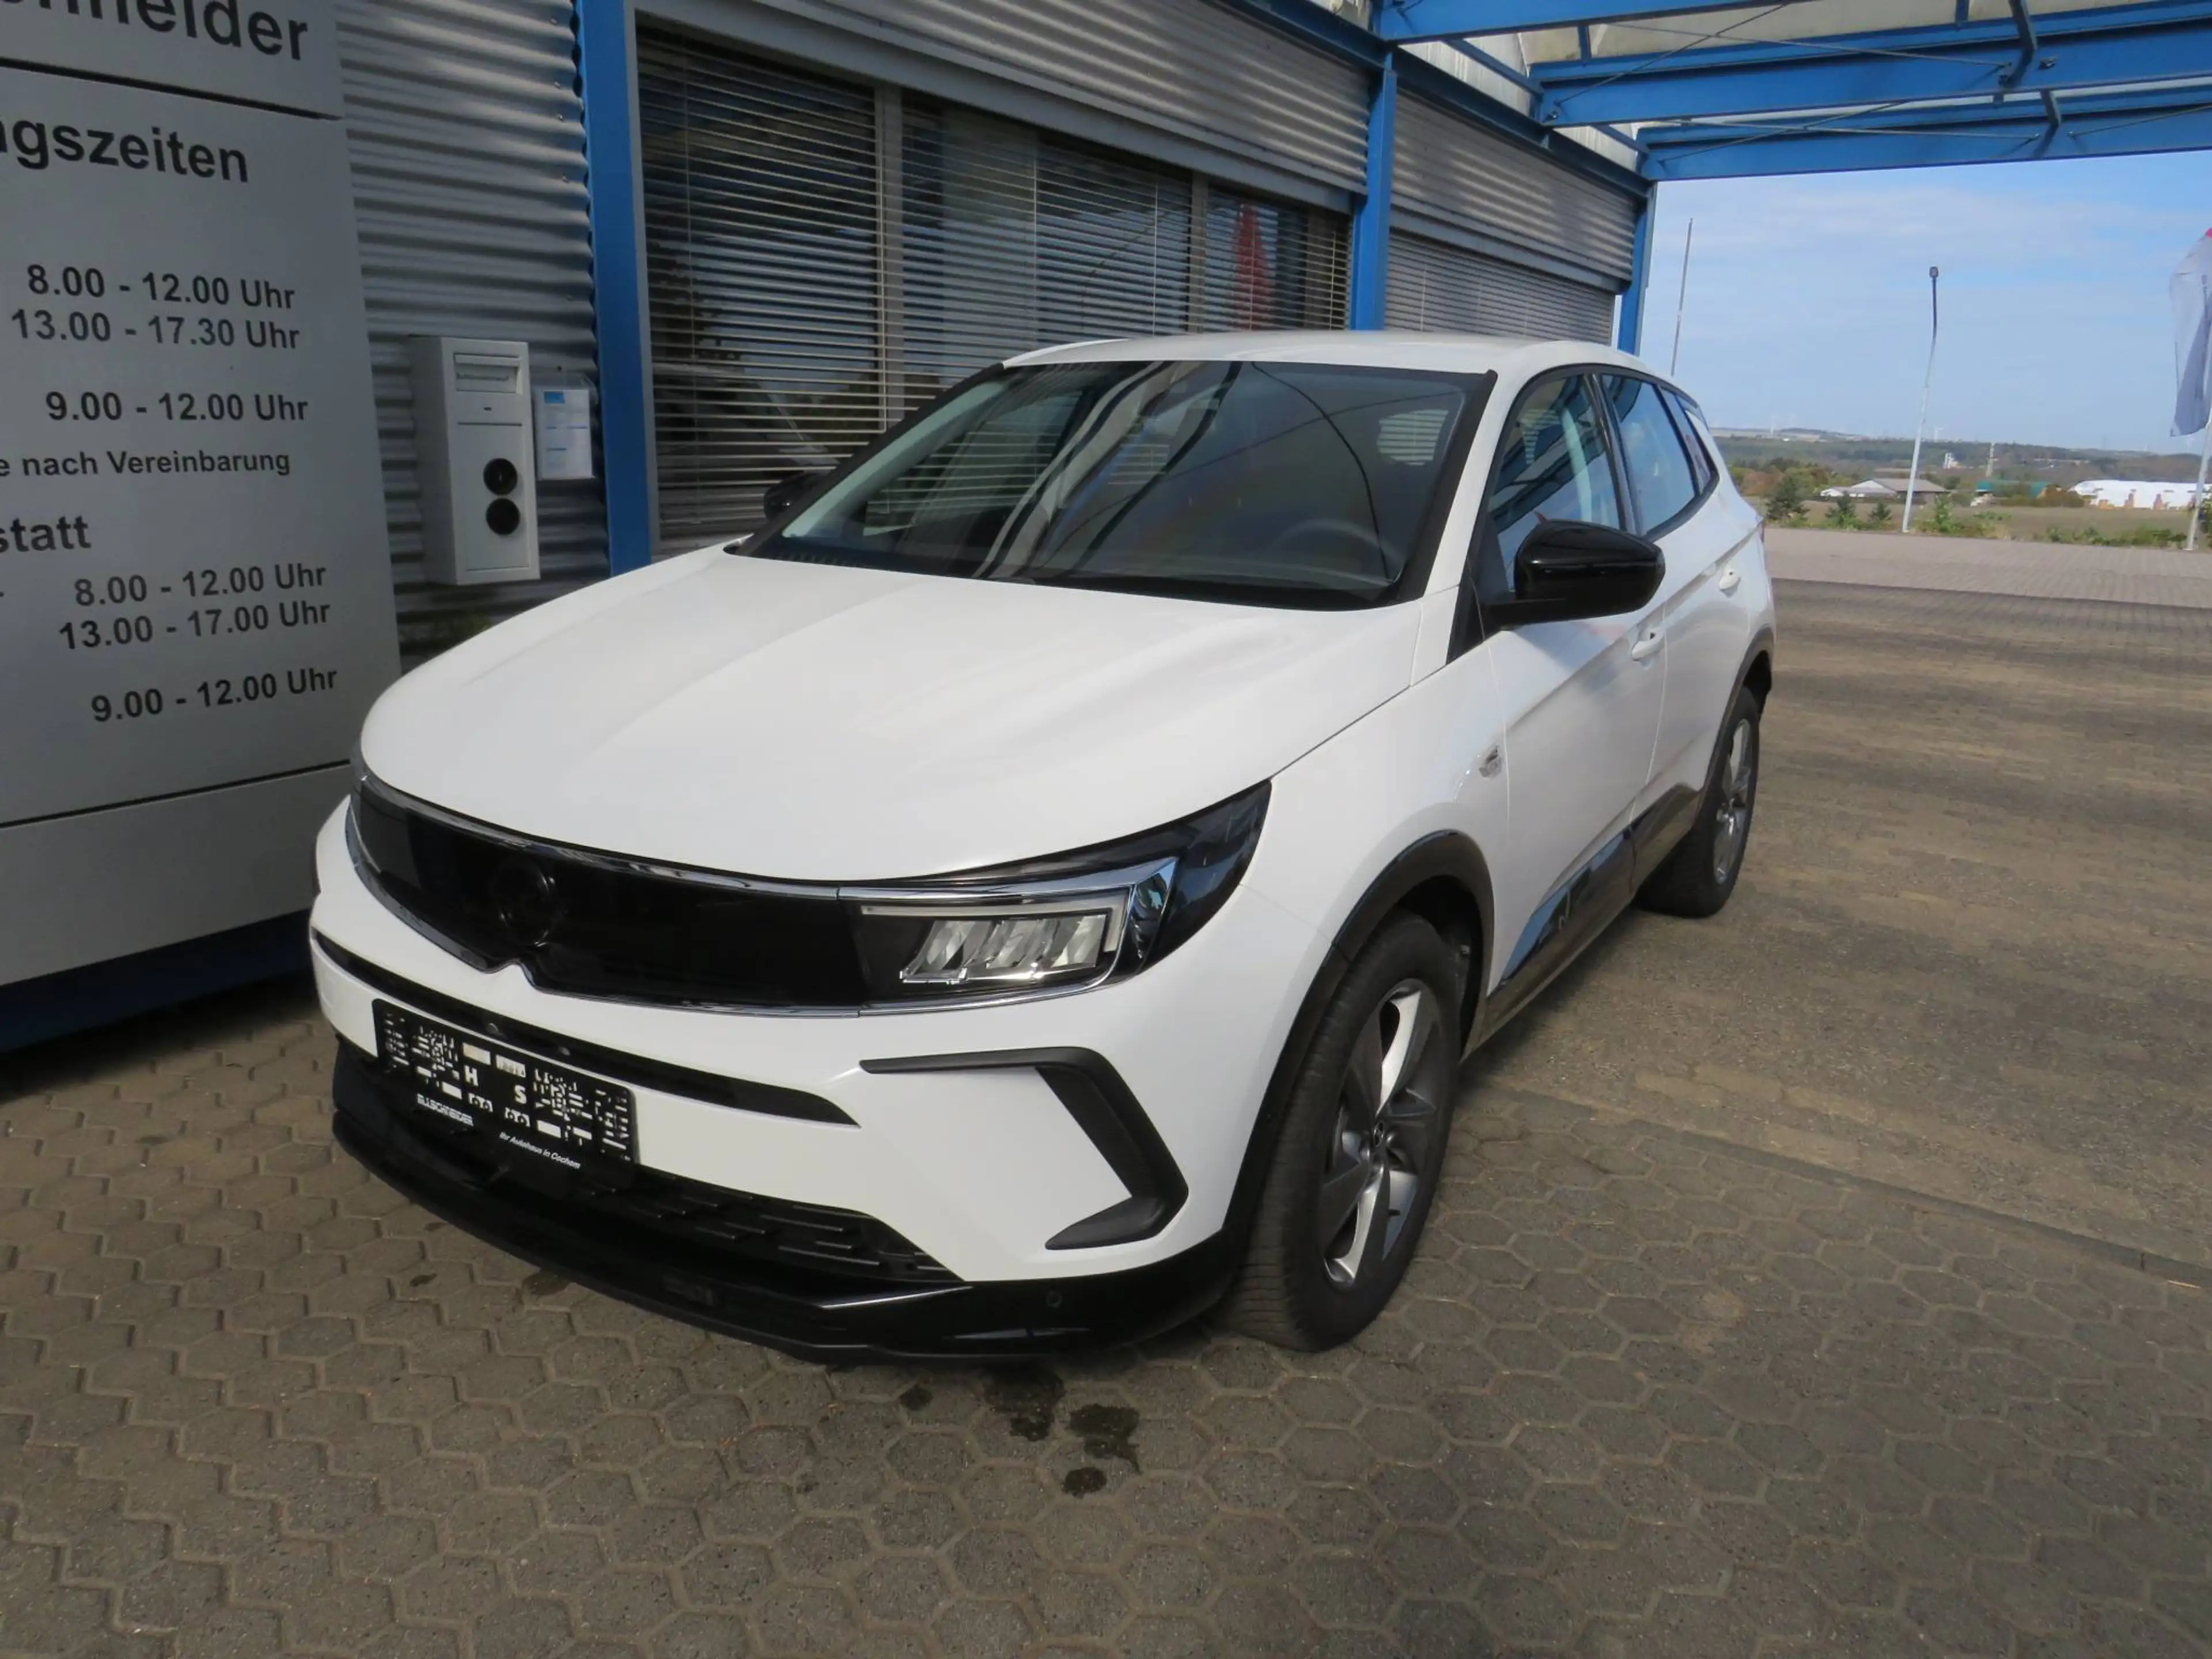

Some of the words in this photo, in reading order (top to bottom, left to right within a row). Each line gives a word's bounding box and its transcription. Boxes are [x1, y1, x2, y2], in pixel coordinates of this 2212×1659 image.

[0, 119, 248, 183] gszeiten
[26, 263, 105, 298] 8.00
[118, 284, 131, 292] -
[141, 271, 230, 306] 12.00
[240, 278, 296, 309] Uhr
[10, 308, 111, 343] 13.00
[124, 328, 137, 336] -
[147, 315, 235, 347] 17.30
[245, 319, 301, 349] Uhr
[45, 391, 123, 422] 9.00
[158, 392, 244, 421] 12.00
[253, 393, 309, 422] Uhr
[22, 451, 99, 476] nach
[106, 449, 290, 476] Vereinbarung
[74, 574, 147, 607] 8.00
[181, 565, 264, 598] 12.00
[274, 562, 327, 590] Uhr
[58, 615, 153, 650] 13.00
[187, 604, 269, 637] 17.00
[279, 600, 331, 627] Uhr
[90, 688, 163, 723] 9.00
[196, 672, 278, 708] 12.00
[286, 667, 338, 695] Uhr
[543, 1149, 551, 1157] in
[550, 1152, 581, 1169] Cochem
